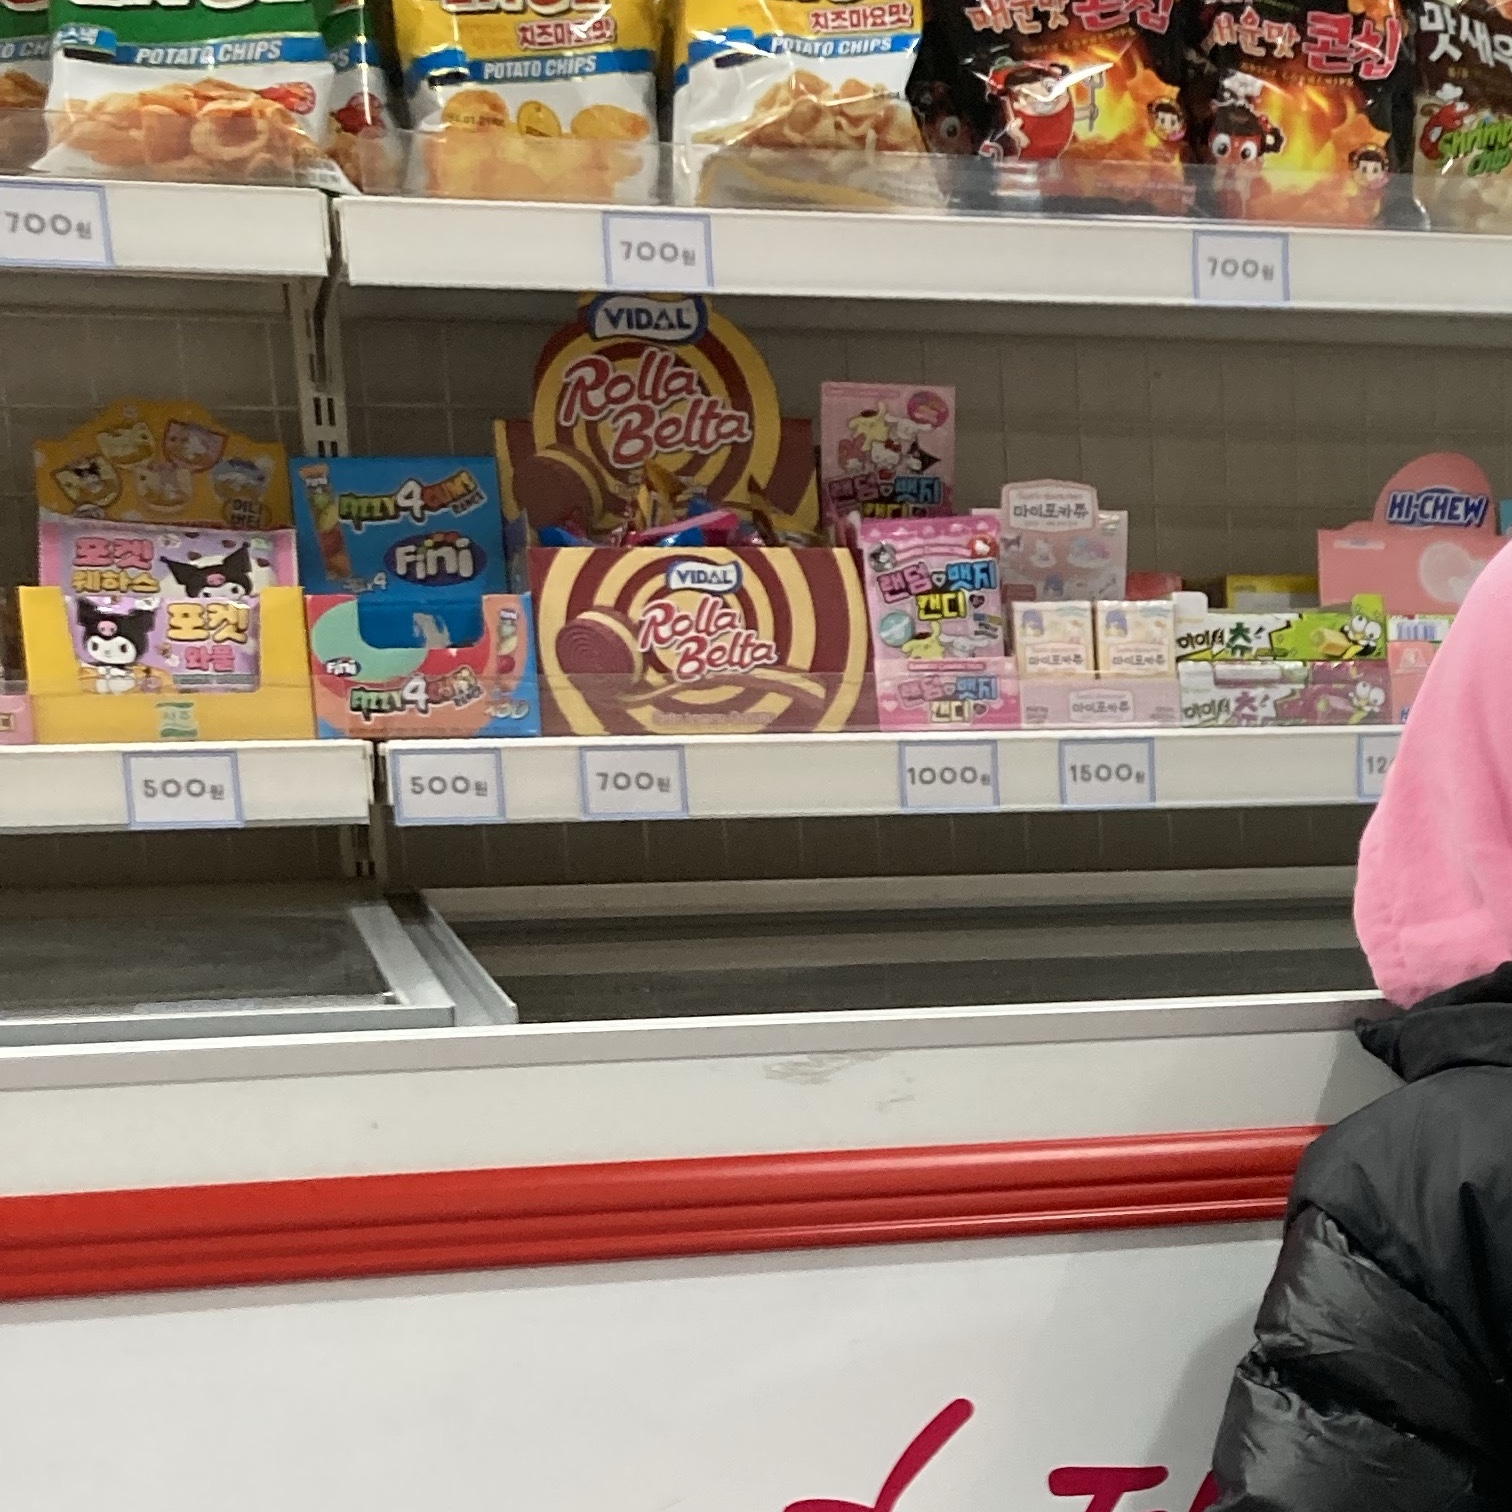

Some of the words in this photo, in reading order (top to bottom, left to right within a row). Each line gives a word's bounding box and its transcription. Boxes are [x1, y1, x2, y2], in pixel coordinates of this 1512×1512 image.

[136, 44, 217, 65] POTATO
[217, 40, 282, 62] CHIPS
[771, 37, 835, 57] POTATO
[841, 37, 894, 54] CHIPS
[483, 61, 544, 80] POTATO
[545, 56, 597, 77] CHIPS
[603, 306, 695, 331] VIDAL
[559, 347, 699, 428] Rolla
[612, 402, 752, 470] Belta
[395, 537, 475, 581] Fini
[676, 568, 733, 586] VIDAL
[637, 594, 741, 653] Rolla
[674, 628, 778, 684] Belta
[141, 778, 226, 801] 500원
[409, 775, 489, 798] 500원
[594, 771, 671, 794] 700원
